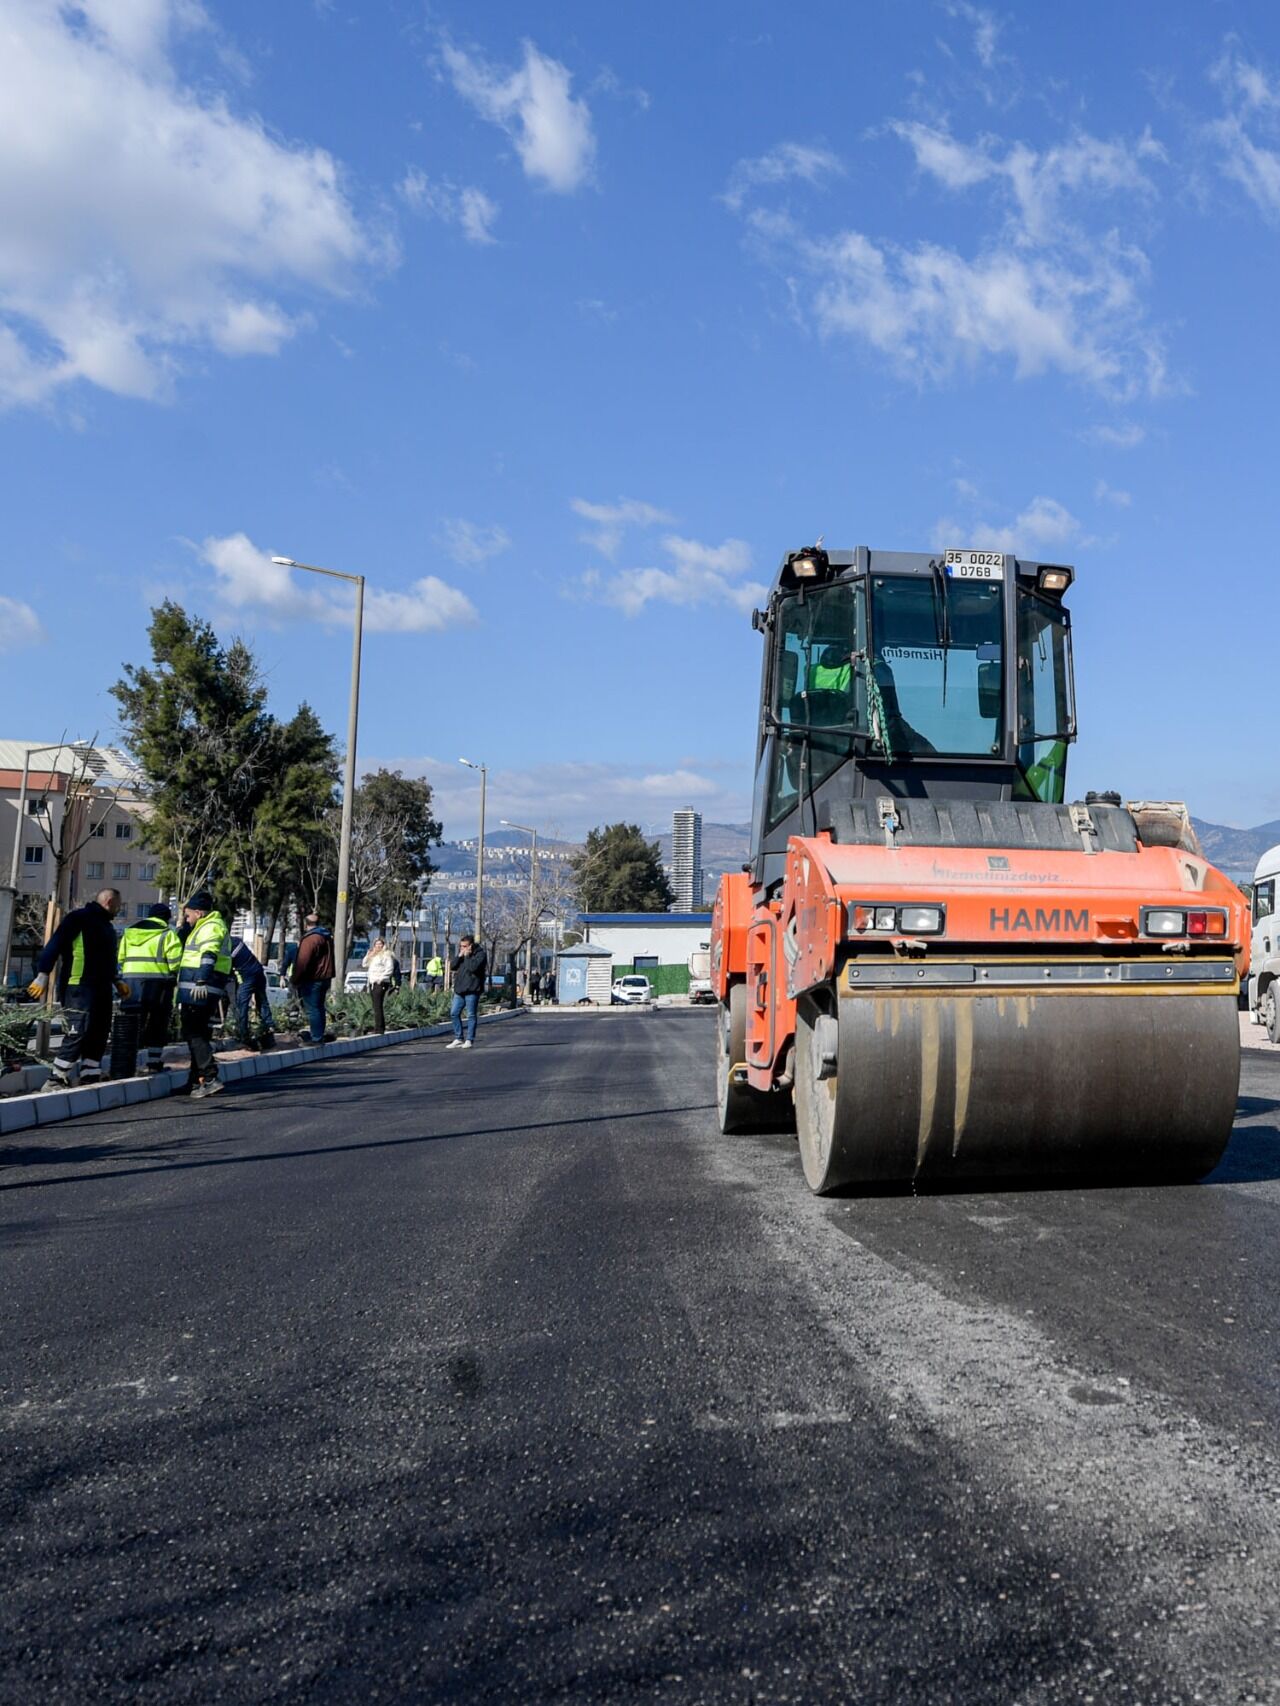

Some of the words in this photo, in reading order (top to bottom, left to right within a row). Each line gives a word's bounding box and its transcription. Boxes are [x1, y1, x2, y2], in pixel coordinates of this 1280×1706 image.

[947, 552, 962, 564] 35
[970, 553, 1001, 566] 0022
[960, 566, 991, 577] 0768
[989, 908, 1089, 931] HAMM
